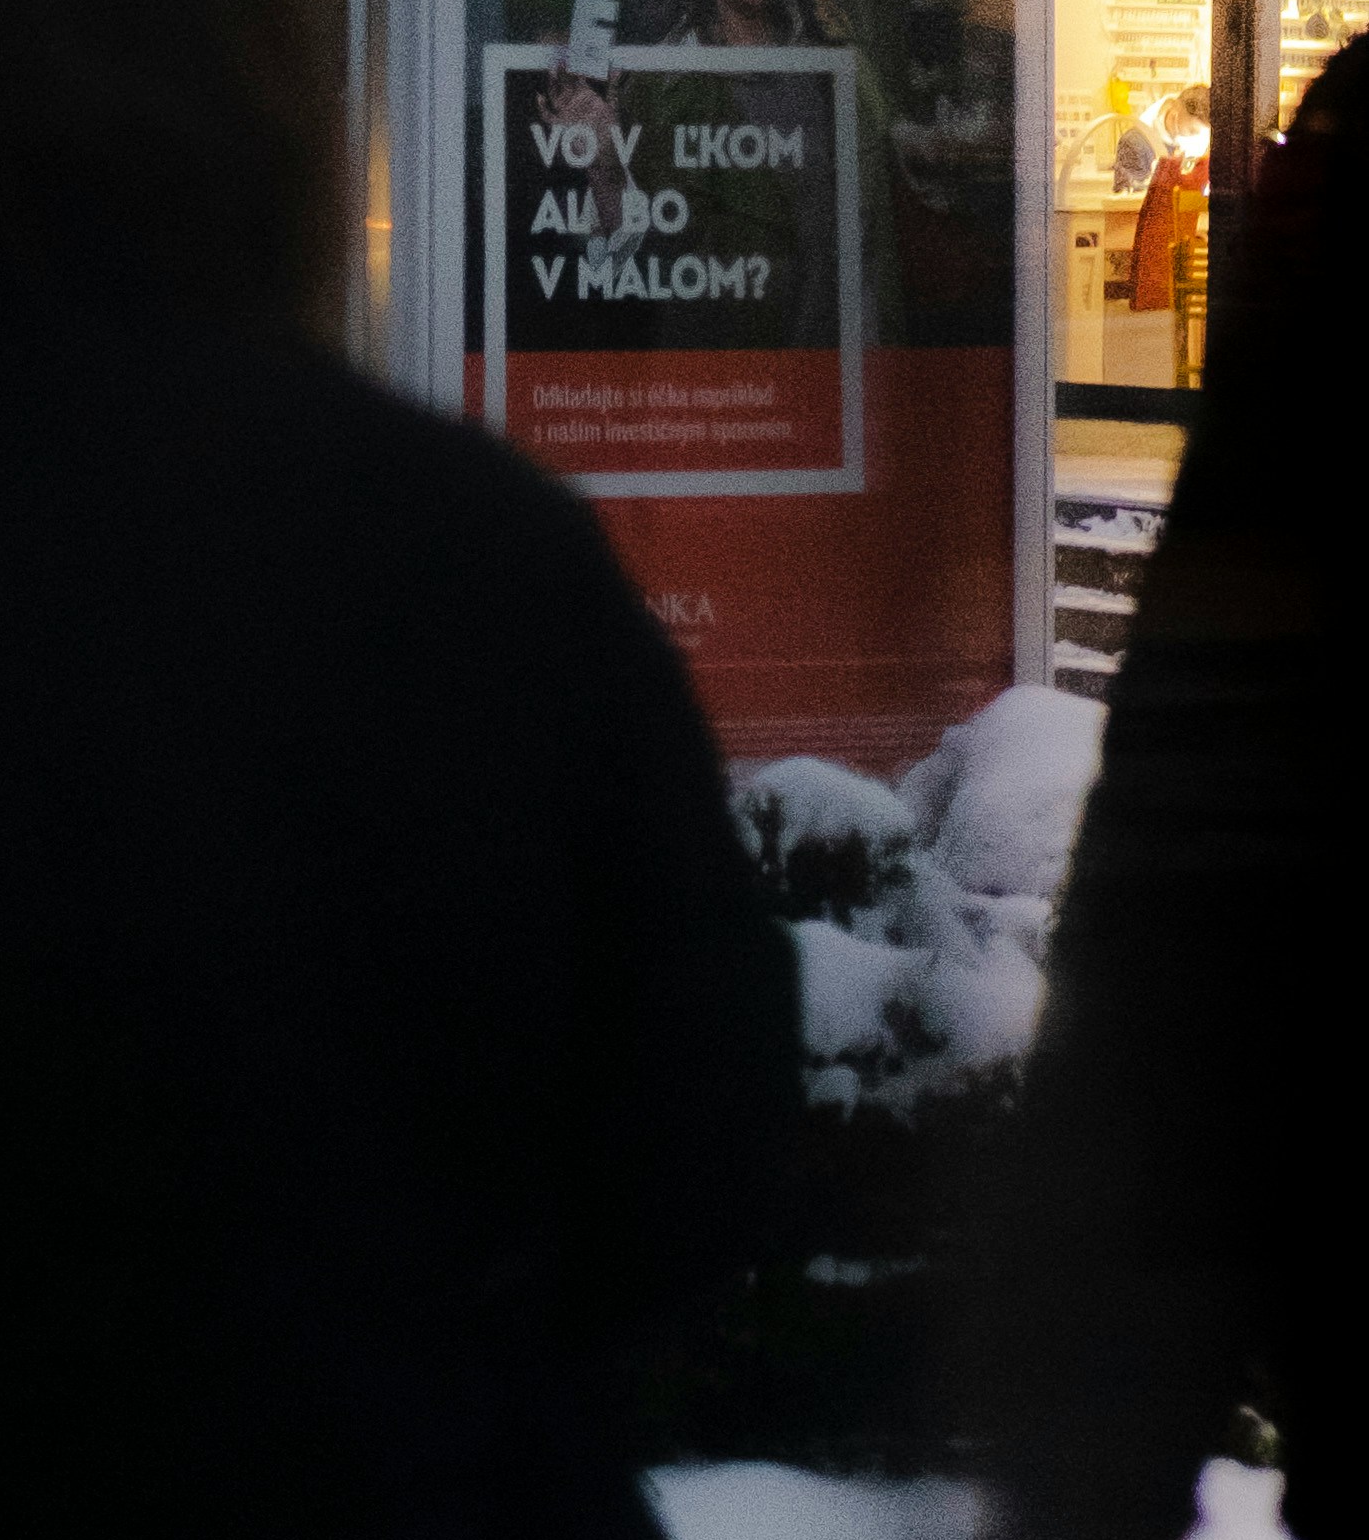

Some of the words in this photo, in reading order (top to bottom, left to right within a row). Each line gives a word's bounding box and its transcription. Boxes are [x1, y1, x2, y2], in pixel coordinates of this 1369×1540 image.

[529, 123, 599, 168] VO
[530, 187, 689, 236] ALBO
[530, 255, 566, 300] V
[577, 252, 771, 300] MALOM?
